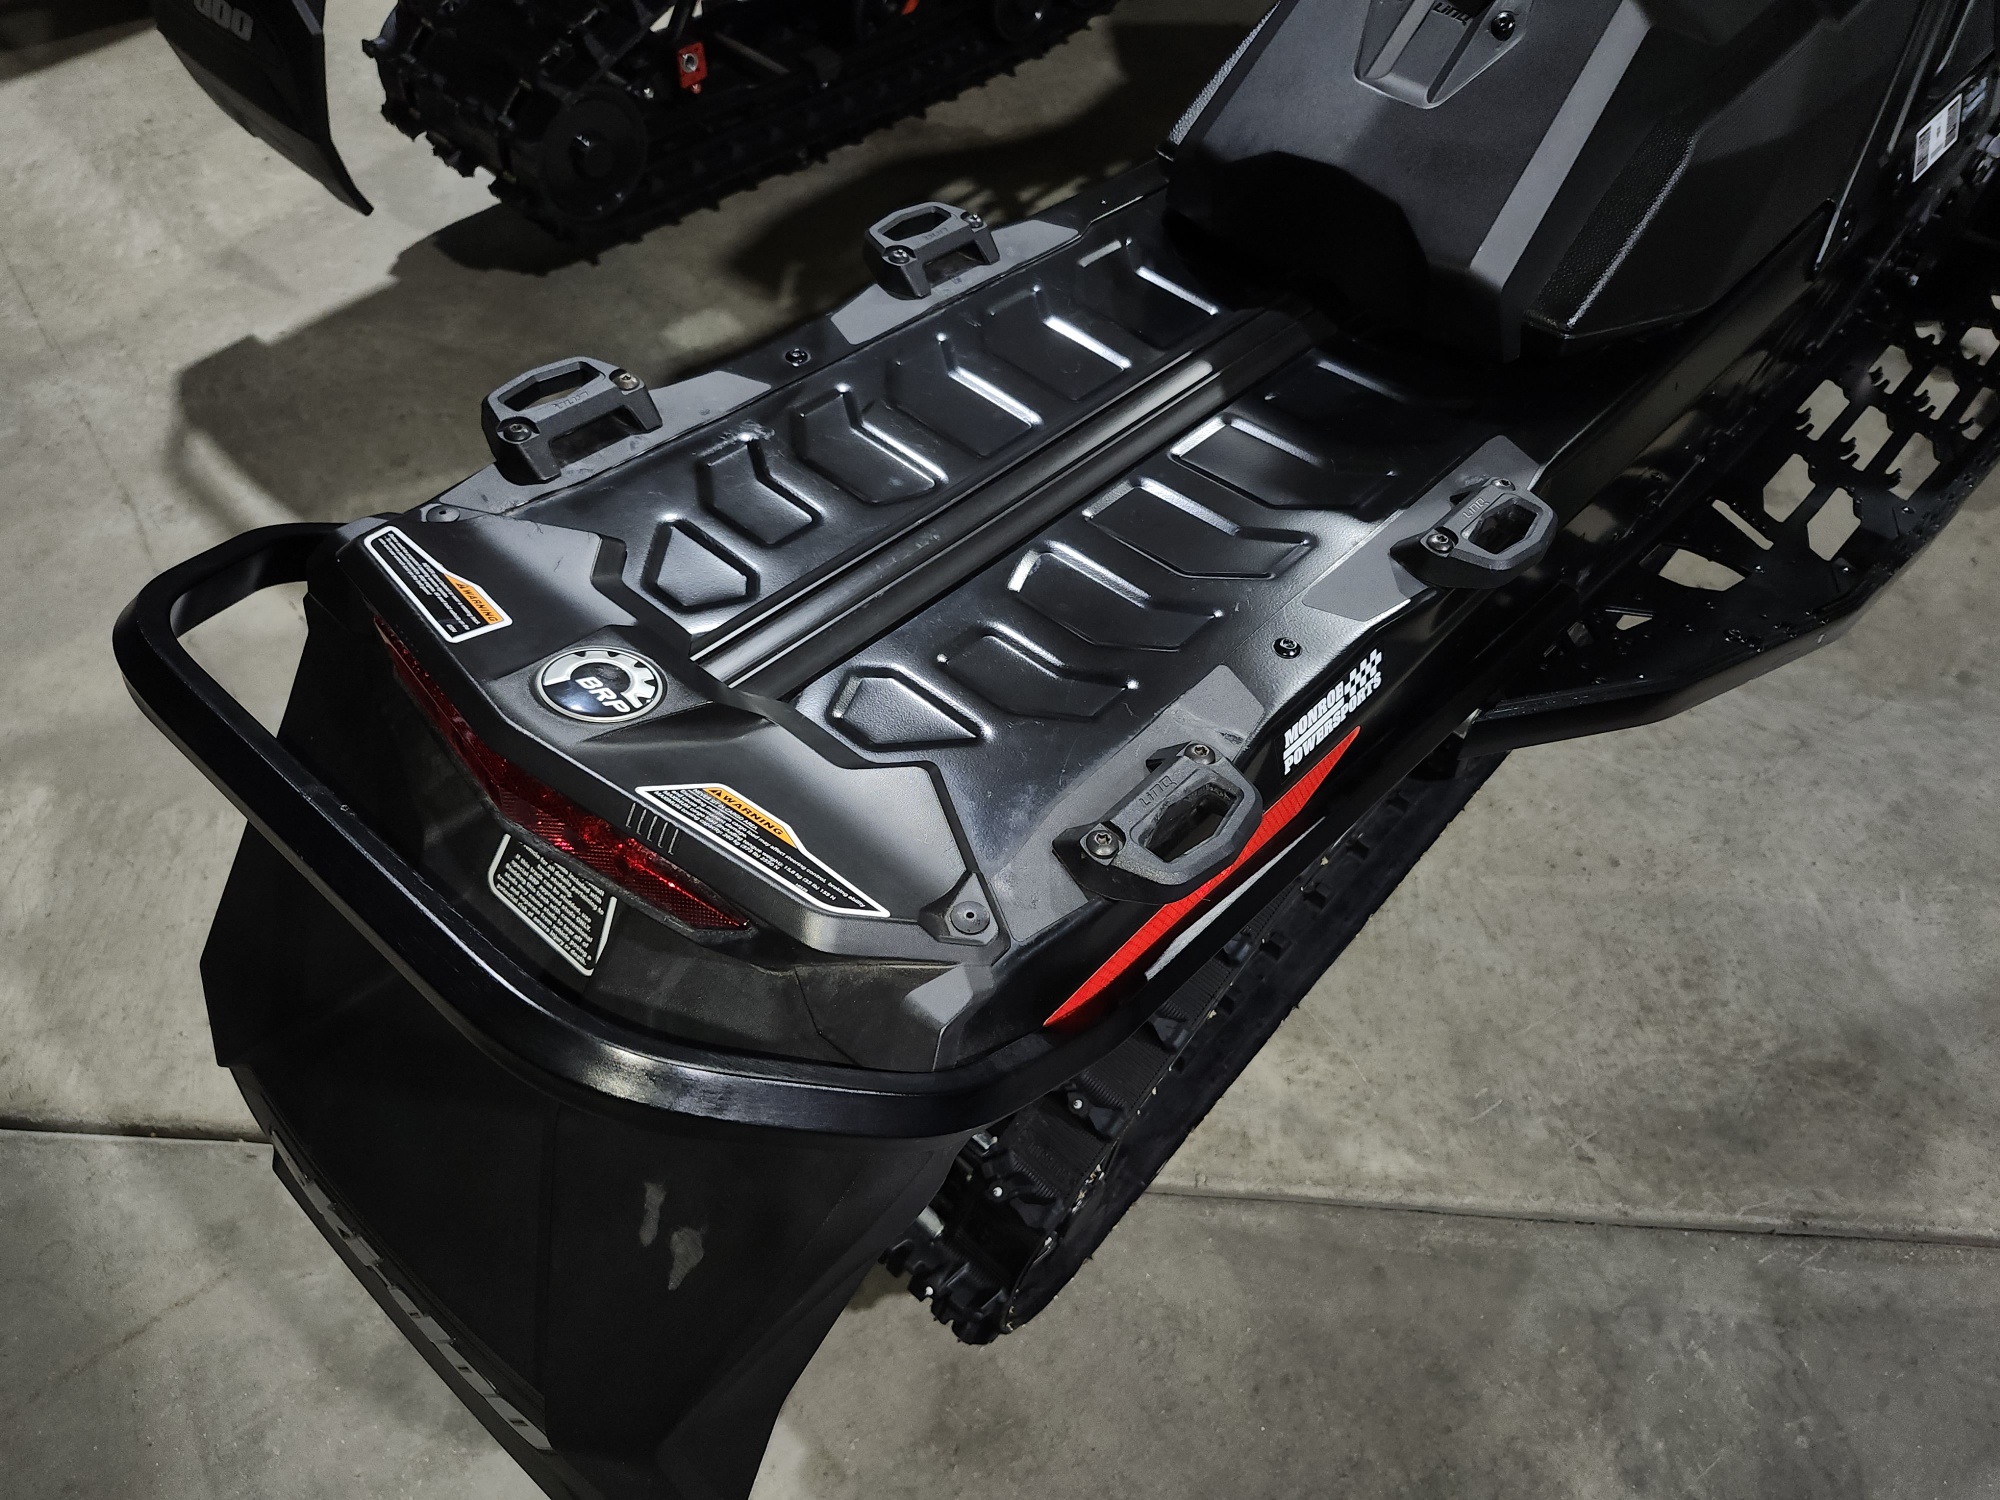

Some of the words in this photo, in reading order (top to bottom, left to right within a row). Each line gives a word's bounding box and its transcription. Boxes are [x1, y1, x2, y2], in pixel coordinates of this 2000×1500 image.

[463, 590, 498, 621] WARNING
[575, 676, 630, 713] BRP
[1284, 671, 1382, 776] POWERSPORTS
[690, 808, 705, 818] cargo
[723, 795, 784, 835] WARNING
[725, 808, 744, 820] CARGO
[743, 820, 757, 830] AREA
[520, 858, 530, 869] this
[530, 866, 543, 881] track
[543, 879, 553, 889] can
[552, 886, 560, 895] be
[581, 912, 591, 923] use
[537, 864, 550, 878] track
[540, 857, 548, 866] for
[547, 864, 555, 872] all
[554, 870, 572, 887] details
[570, 885, 598, 910] pertaining
[597, 907, 604, 915] to
[568, 872, 590, 893] included
[589, 891, 602, 904] with
[732, 821, 747, 832] cargo
[747, 830, 760, 839] load
[758, 838, 771, 847] may
[785, 855, 806, 870] steering
[828, 882, 848, 897] braking
[848, 896, 865, 907] ability
[496, 883, 518, 904] potential
[517, 902, 528, 913] risk
[533, 916, 550, 932] severe
[549, 930, 565, 946] injury
[570, 949, 586, 965] death.
[497, 874, 510, 888] track
[509, 886, 520, 896] and
[519, 894, 540, 915] separate
[540, 912, 552, 926] from
[552, 924, 570, 941] vehicle
[569, 940, 587, 957] posing
[504, 872, 518, 885] studs
[517, 884, 528, 895] may
[528, 893, 543, 908] cause
[543, 906, 557, 921] studs
[557, 918, 563, 926] to
[563, 924, 574, 935] tear
[573, 934, 582, 942] off
[511, 860, 529, 877] special
[528, 874, 539, 885] BRP
[538, 885, 562, 906] approved
[561, 904, 576, 918] studs
[575, 916, 591, 932] ONLY.
[526, 882, 536, 893] this
[536, 890, 550, 904] track
[549, 903, 561, 915] with
[560, 913, 593, 942] conventional
